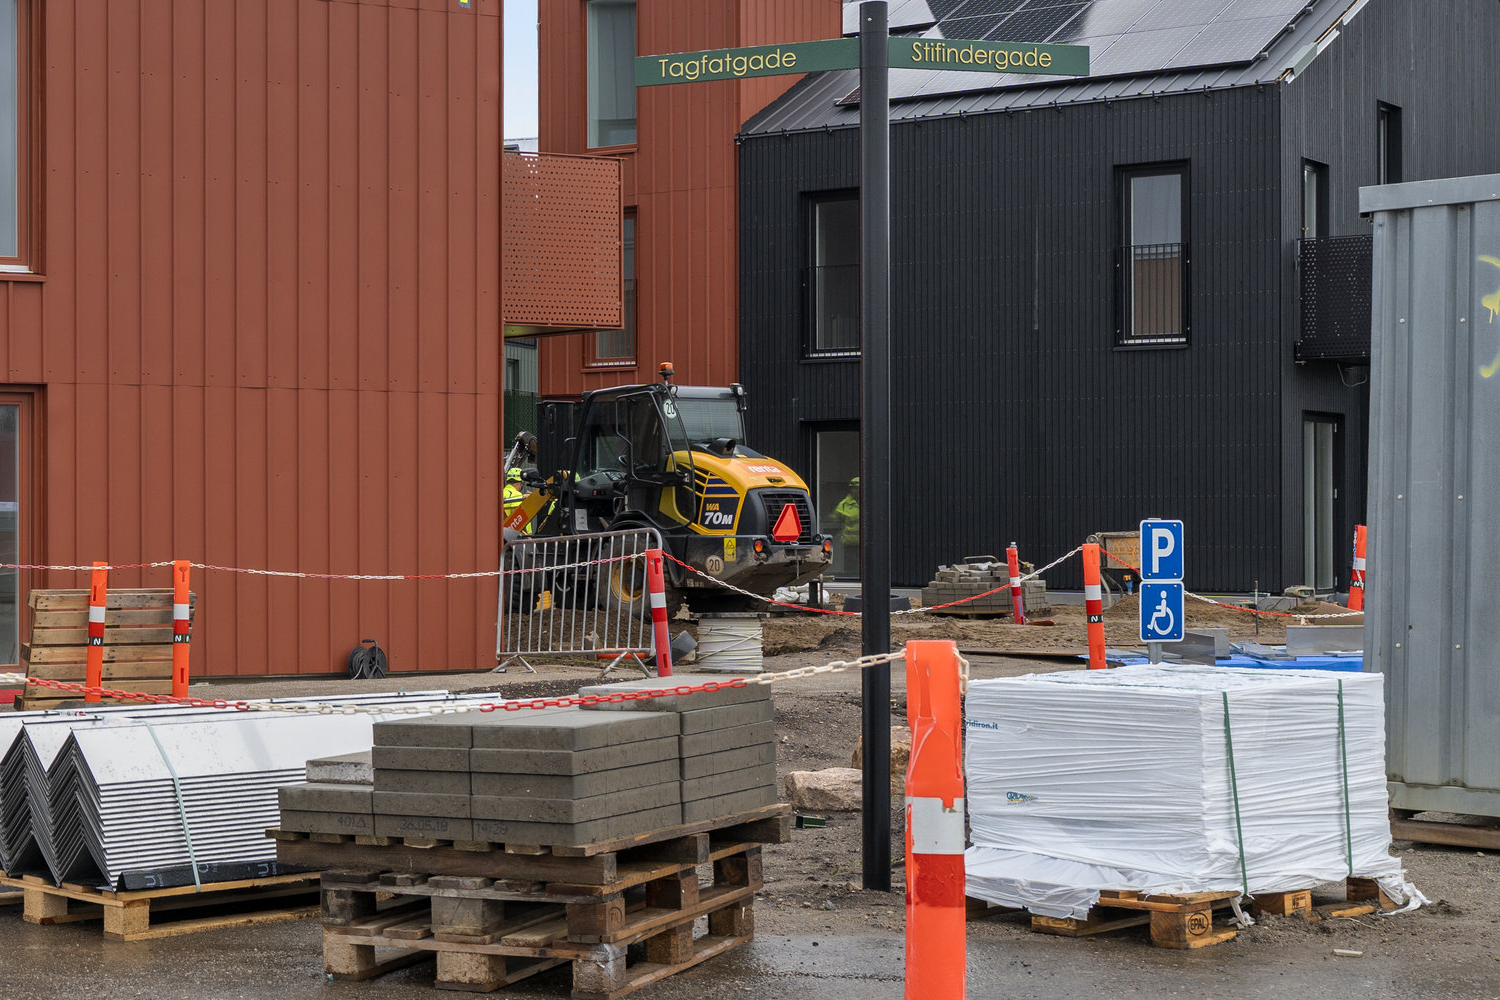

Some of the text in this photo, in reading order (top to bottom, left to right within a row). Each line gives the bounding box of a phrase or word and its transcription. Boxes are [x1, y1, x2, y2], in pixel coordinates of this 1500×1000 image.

[911, 42, 1052, 70] Stifindergade
[658, 49, 797, 81] Tagfatgade
[747, 465, 781, 473] renta
[706, 503, 720, 511] WA
[704, 512, 733, 525] 70M
[1152, 528, 1175, 574] P
[709, 559, 720, 572] 20
[966, 719, 998, 729] ridiron.it
